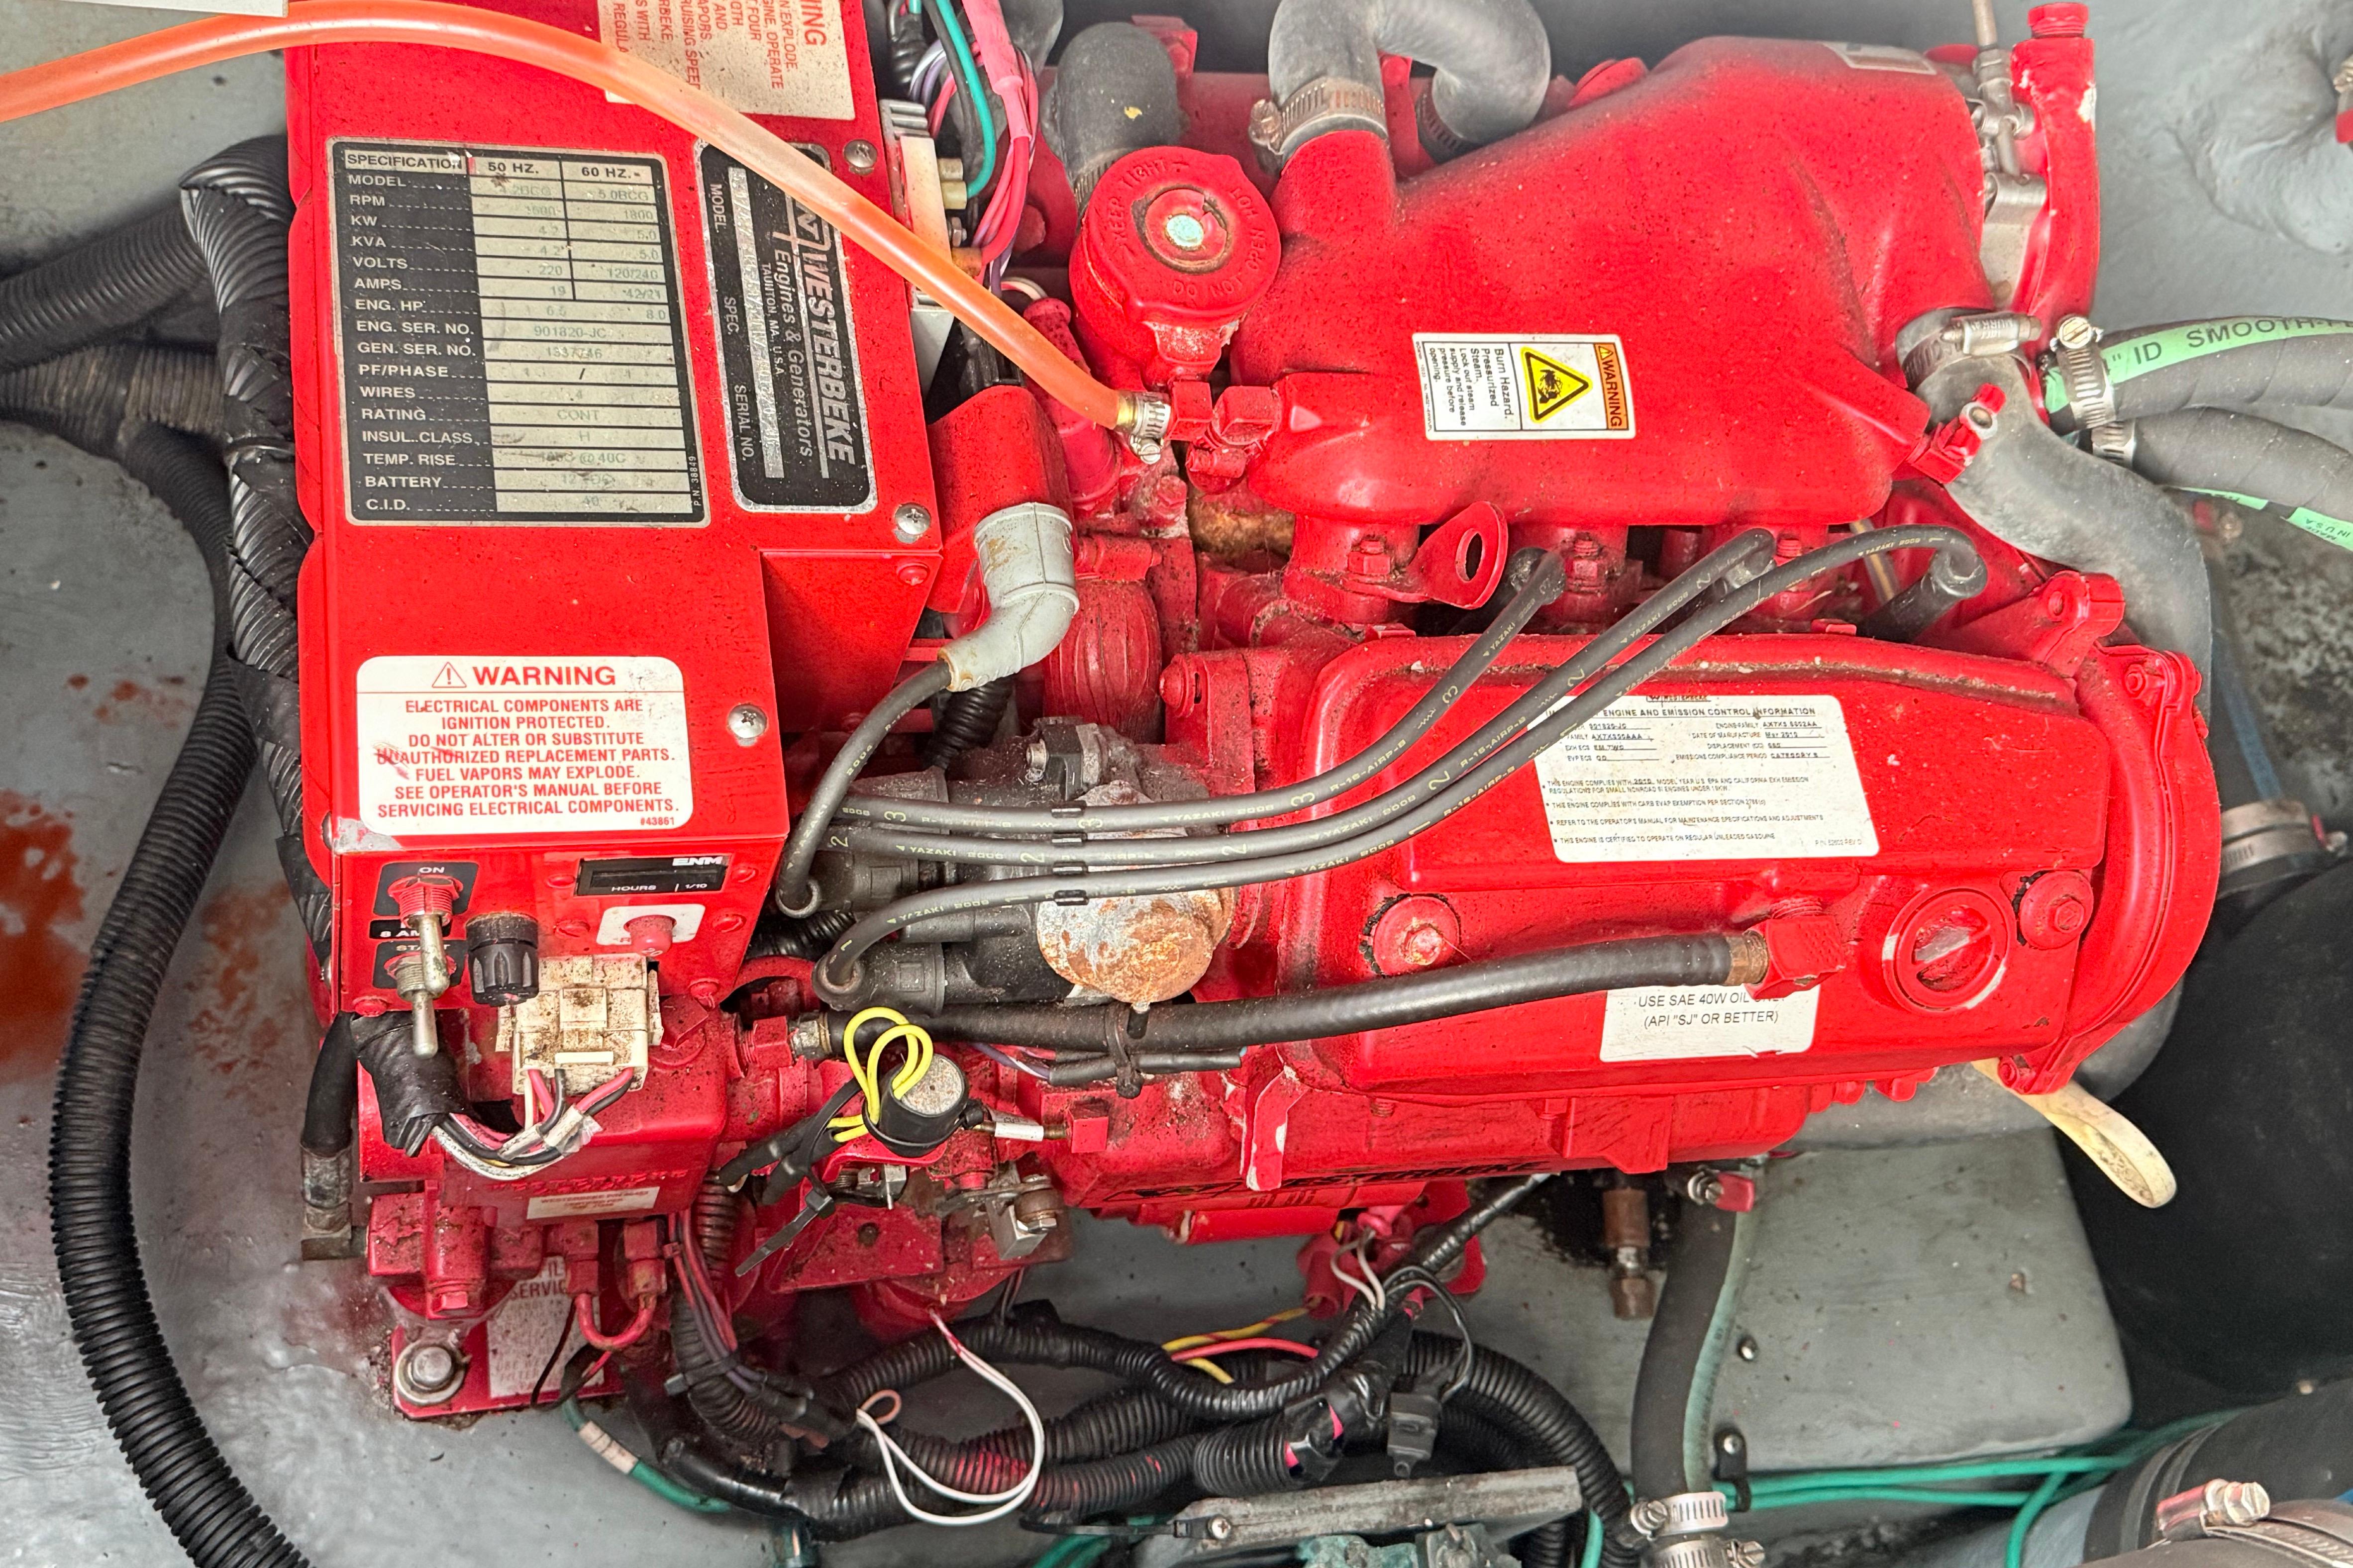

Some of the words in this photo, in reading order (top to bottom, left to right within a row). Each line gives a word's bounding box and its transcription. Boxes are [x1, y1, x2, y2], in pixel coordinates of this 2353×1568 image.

[636, 10, 649, 41] WITH
[715, 2, 727, 30] AND
[748, 7, 762, 41] FOUR
[765, 31, 784, 89] OPERATE
[347, 154, 462, 170] SPECIFICATION
[488, 162, 506, 173] 50
[512, 164, 539, 174] HZ.
[582, 167, 600, 177] 60
[1120, 159, 1167, 188] TIGHT
[348, 175, 407, 187] MODEL
[350, 195, 385, 207] RPM
[1229, 188, 1258, 219] HOT
[351, 215, 378, 226] KW
[352, 236, 387, 248] KVA
[1245, 228, 1266, 271] OPEN
[352, 257, 409, 270] VOLTS
[539, 265, 563, 276] 220
[354, 278, 403, 291] AMPS
[552, 286, 566, 296] 19
[760, 263, 777, 317] TAUNTON,
[774, 248, 796, 324] Engines
[1172, 280, 1198, 297] DO
[1210, 275, 1243, 297] NOT
[355, 299, 396, 311] ENG.
[400, 301, 424, 311] HP
[723, 297, 740, 335] SPEC.
[356, 320, 397, 332] ENG.
[402, 321, 441, 334] SER.
[445, 323, 475, 335] NO.
[533, 325, 607, 339] 901820-JC
[785, 324, 802, 343] &
[357, 341, 399, 354] GEN.
[403, 343, 442, 356] SER.
[447, 345, 477, 357] NO.
[802, 252, 856, 465] WESTERBEKE
[2134, 341, 2162, 365] ID
[1429, 347, 1442, 383] opening.
[1449, 347, 1460, 374] supply
[1470, 348, 1483, 382] Steam.
[1494, 348, 1507, 374] Burn
[358, 364, 449, 378] PF/PHASE
[1438, 347, 1452, 384] pressure
[1446, 386, 1456, 413] before
[1459, 348, 1470, 368] Lock
[1466, 385, 1476, 411] steam
[1481, 348, 1499, 407] Pressurized
[359, 386, 416, 398] WIRES
[1455, 377, 1464, 392] and
[1601, 359, 1623, 428] WARNING
[787, 349, 813, 457] Generators
[1499, 377, 1514, 419] Hazard.
[361, 408, 426, 421] RATING
[557, 409, 600, 421] CONT
[734, 385, 749, 433] SERIAL
[1457, 394, 1467, 426] release
[740, 436, 755, 461] NO.
[363, 453, 414, 466] TEMP.
[417, 454, 456, 466] RISE
[688, 456, 699, 486] 38849
[365, 476, 442, 489] BATTERY
[366, 498, 410, 511] C.I.D.
[1630, 612, 1662, 638] YAZAKI
[1491, 621, 1516, 651] YAZAKI
[472, 666, 616, 686] WARNING
[405, 699, 500, 714] ELECTRICAL
[504, 699, 611, 713] COMPONENTS
[614, 698, 644, 712] ARE
[441, 716, 512, 730] IGNITION
[516, 715, 611, 730] PROTECTED.
[409, 734, 431, 748] DO
[436, 733, 467, 747] NOT
[473, 733, 520, 747] ALTER
[525, 733, 547, 746] OR
[551, 732, 645, 746] SUBSTITUTE
[505, 749, 617, 764] REPLACEMENT
[622, 748, 676, 762] PARTS.
[415, 768, 455, 782] FUEL
[460, 767, 523, 781] VAPORS
[528, 766, 562, 781] MAY
[566, 765, 641, 780] EXPLODE.
[395, 785, 424, 799] SEE
[429, 784, 528, 799] OPERATOR'S
[533, 783, 600, 797] MANUAL
[604, 782, 662, 796] BEFORE
[378, 803, 464, 818] SERVICING
[469, 801, 563, 816] ELECTRICAL
[568, 798, 680, 814] COMPONENTS.
[1323, 816, 1373, 838] YAZAKI
[1428, 770, 1451, 790] 2
[640, 816, 675, 826] #43861
[1174, 810, 1226, 821] YAZAKI
[672, 856, 723, 866] ENM
[910, 846, 956, 857] YAZAKI
[1299, 856, 1350, 874] YAZAKI
[642, 947, 663, 957] 20
[1638, 995, 1665, 1008] USE
[1669, 994, 1695, 1006] SAE
[1699, 993, 1728, 1005] 40W
[1731, 992, 1750, 1004] OIL
[1644, 1015, 1670, 1030] (API
[1672, 1014, 1698, 1026] "SJ"
[1701, 1013, 1720, 1025] OR
[1724, 1010, 1779, 1024] BETTER)
